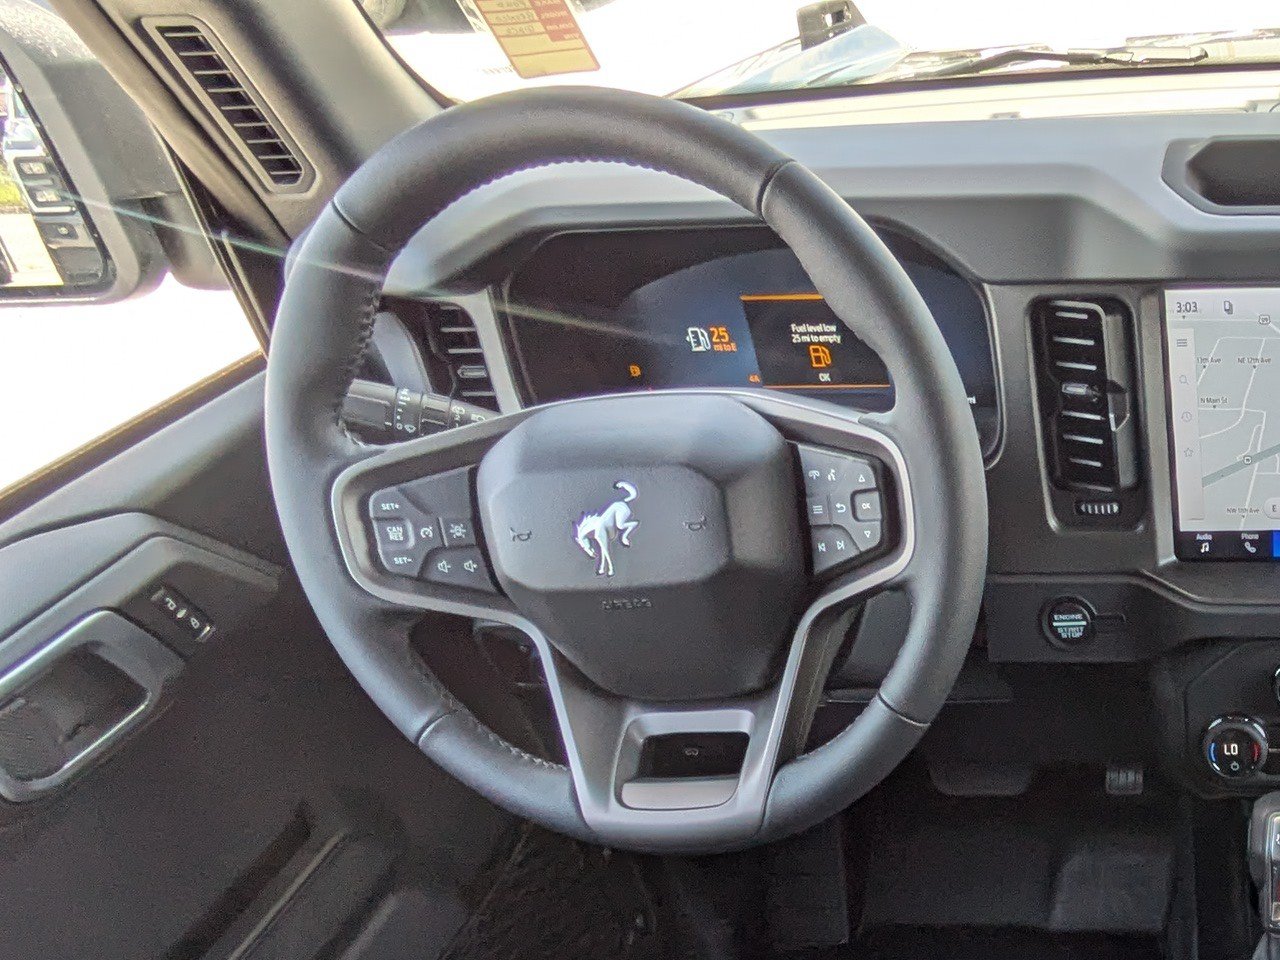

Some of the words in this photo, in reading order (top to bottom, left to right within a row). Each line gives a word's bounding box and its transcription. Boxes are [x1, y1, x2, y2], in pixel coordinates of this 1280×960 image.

[1176, 301, 1198, 313] 3:03
[791, 323, 806, 333] Fuel
[806, 323, 823, 333] level
[823, 323, 837, 333] low
[710, 326, 731, 342] 25
[791, 334, 801, 343] 25
[801, 334, 810, 343] mi
[810, 334, 819, 343] to
[819, 334, 841, 344] empty
[818, 373, 831, 382] OK
[381, 502, 400, 511] SET+
[861, 502, 872, 510] OK
[1272, 504, 1277, 512] E
[1195, 533, 1212, 541] Audio
[1223, 743, 1239, 755] LO
